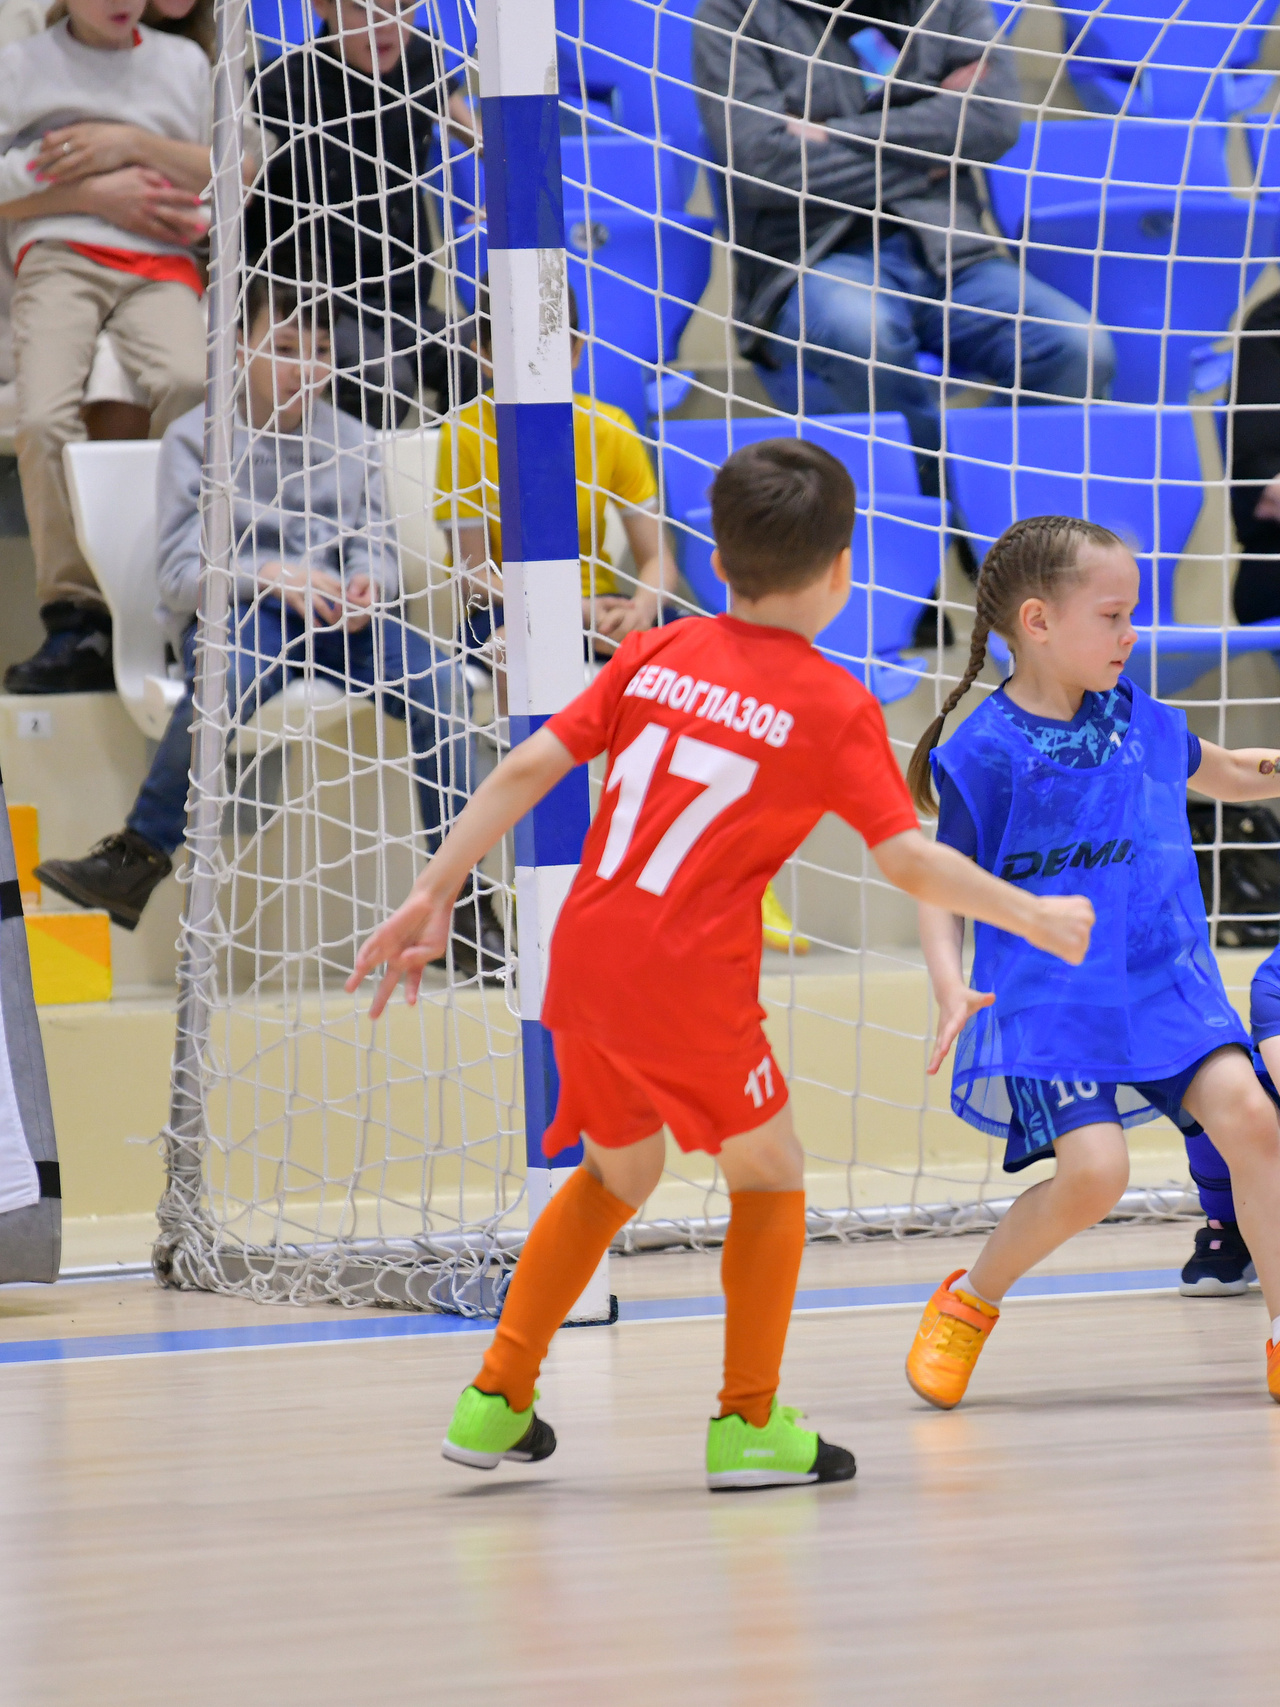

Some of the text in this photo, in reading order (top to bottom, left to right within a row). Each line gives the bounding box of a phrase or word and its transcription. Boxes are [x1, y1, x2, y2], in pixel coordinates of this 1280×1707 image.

[623, 664, 794, 748] БЕЛОГЛАЗОВ
[596, 721, 760, 897] 17
[1000, 838, 1136, 881] DEMI
